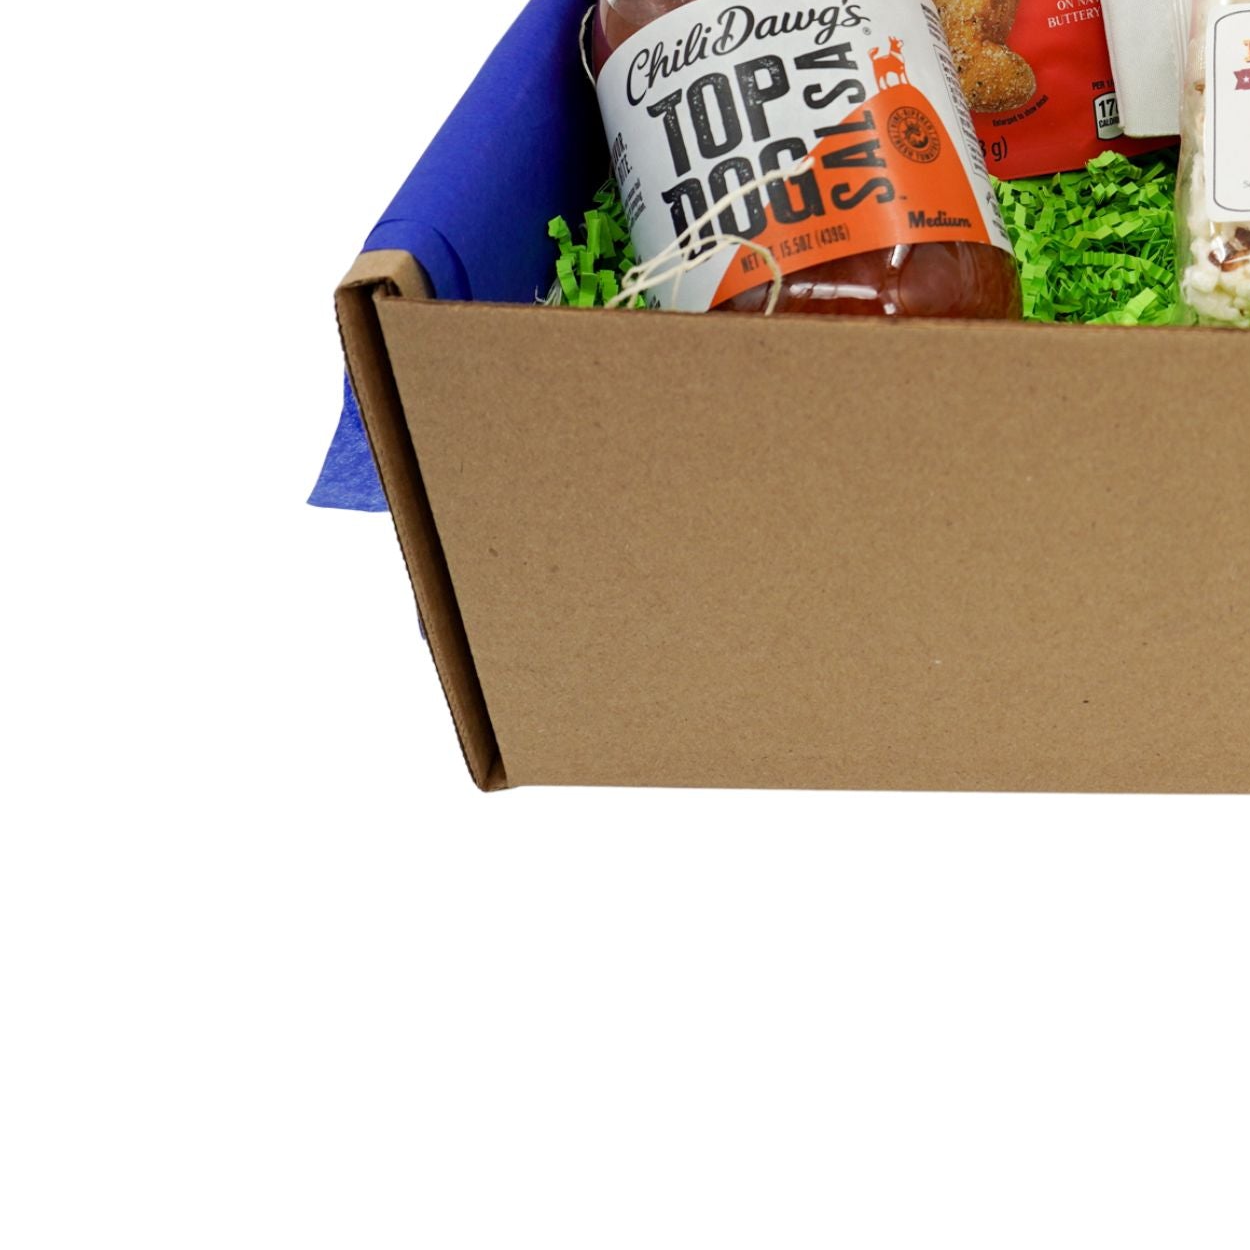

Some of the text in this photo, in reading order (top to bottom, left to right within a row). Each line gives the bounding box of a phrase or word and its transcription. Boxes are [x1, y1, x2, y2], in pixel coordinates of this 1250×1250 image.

[626, 22, 712, 107] Chili
[646, 54, 791, 177] TOP
[794, 41, 895, 211] SALSA
[1099, 98, 1119, 118] 17
[661, 137, 825, 261] DOG
[908, 210, 972, 229] Medium
[741, 252, 759, 273] NET
